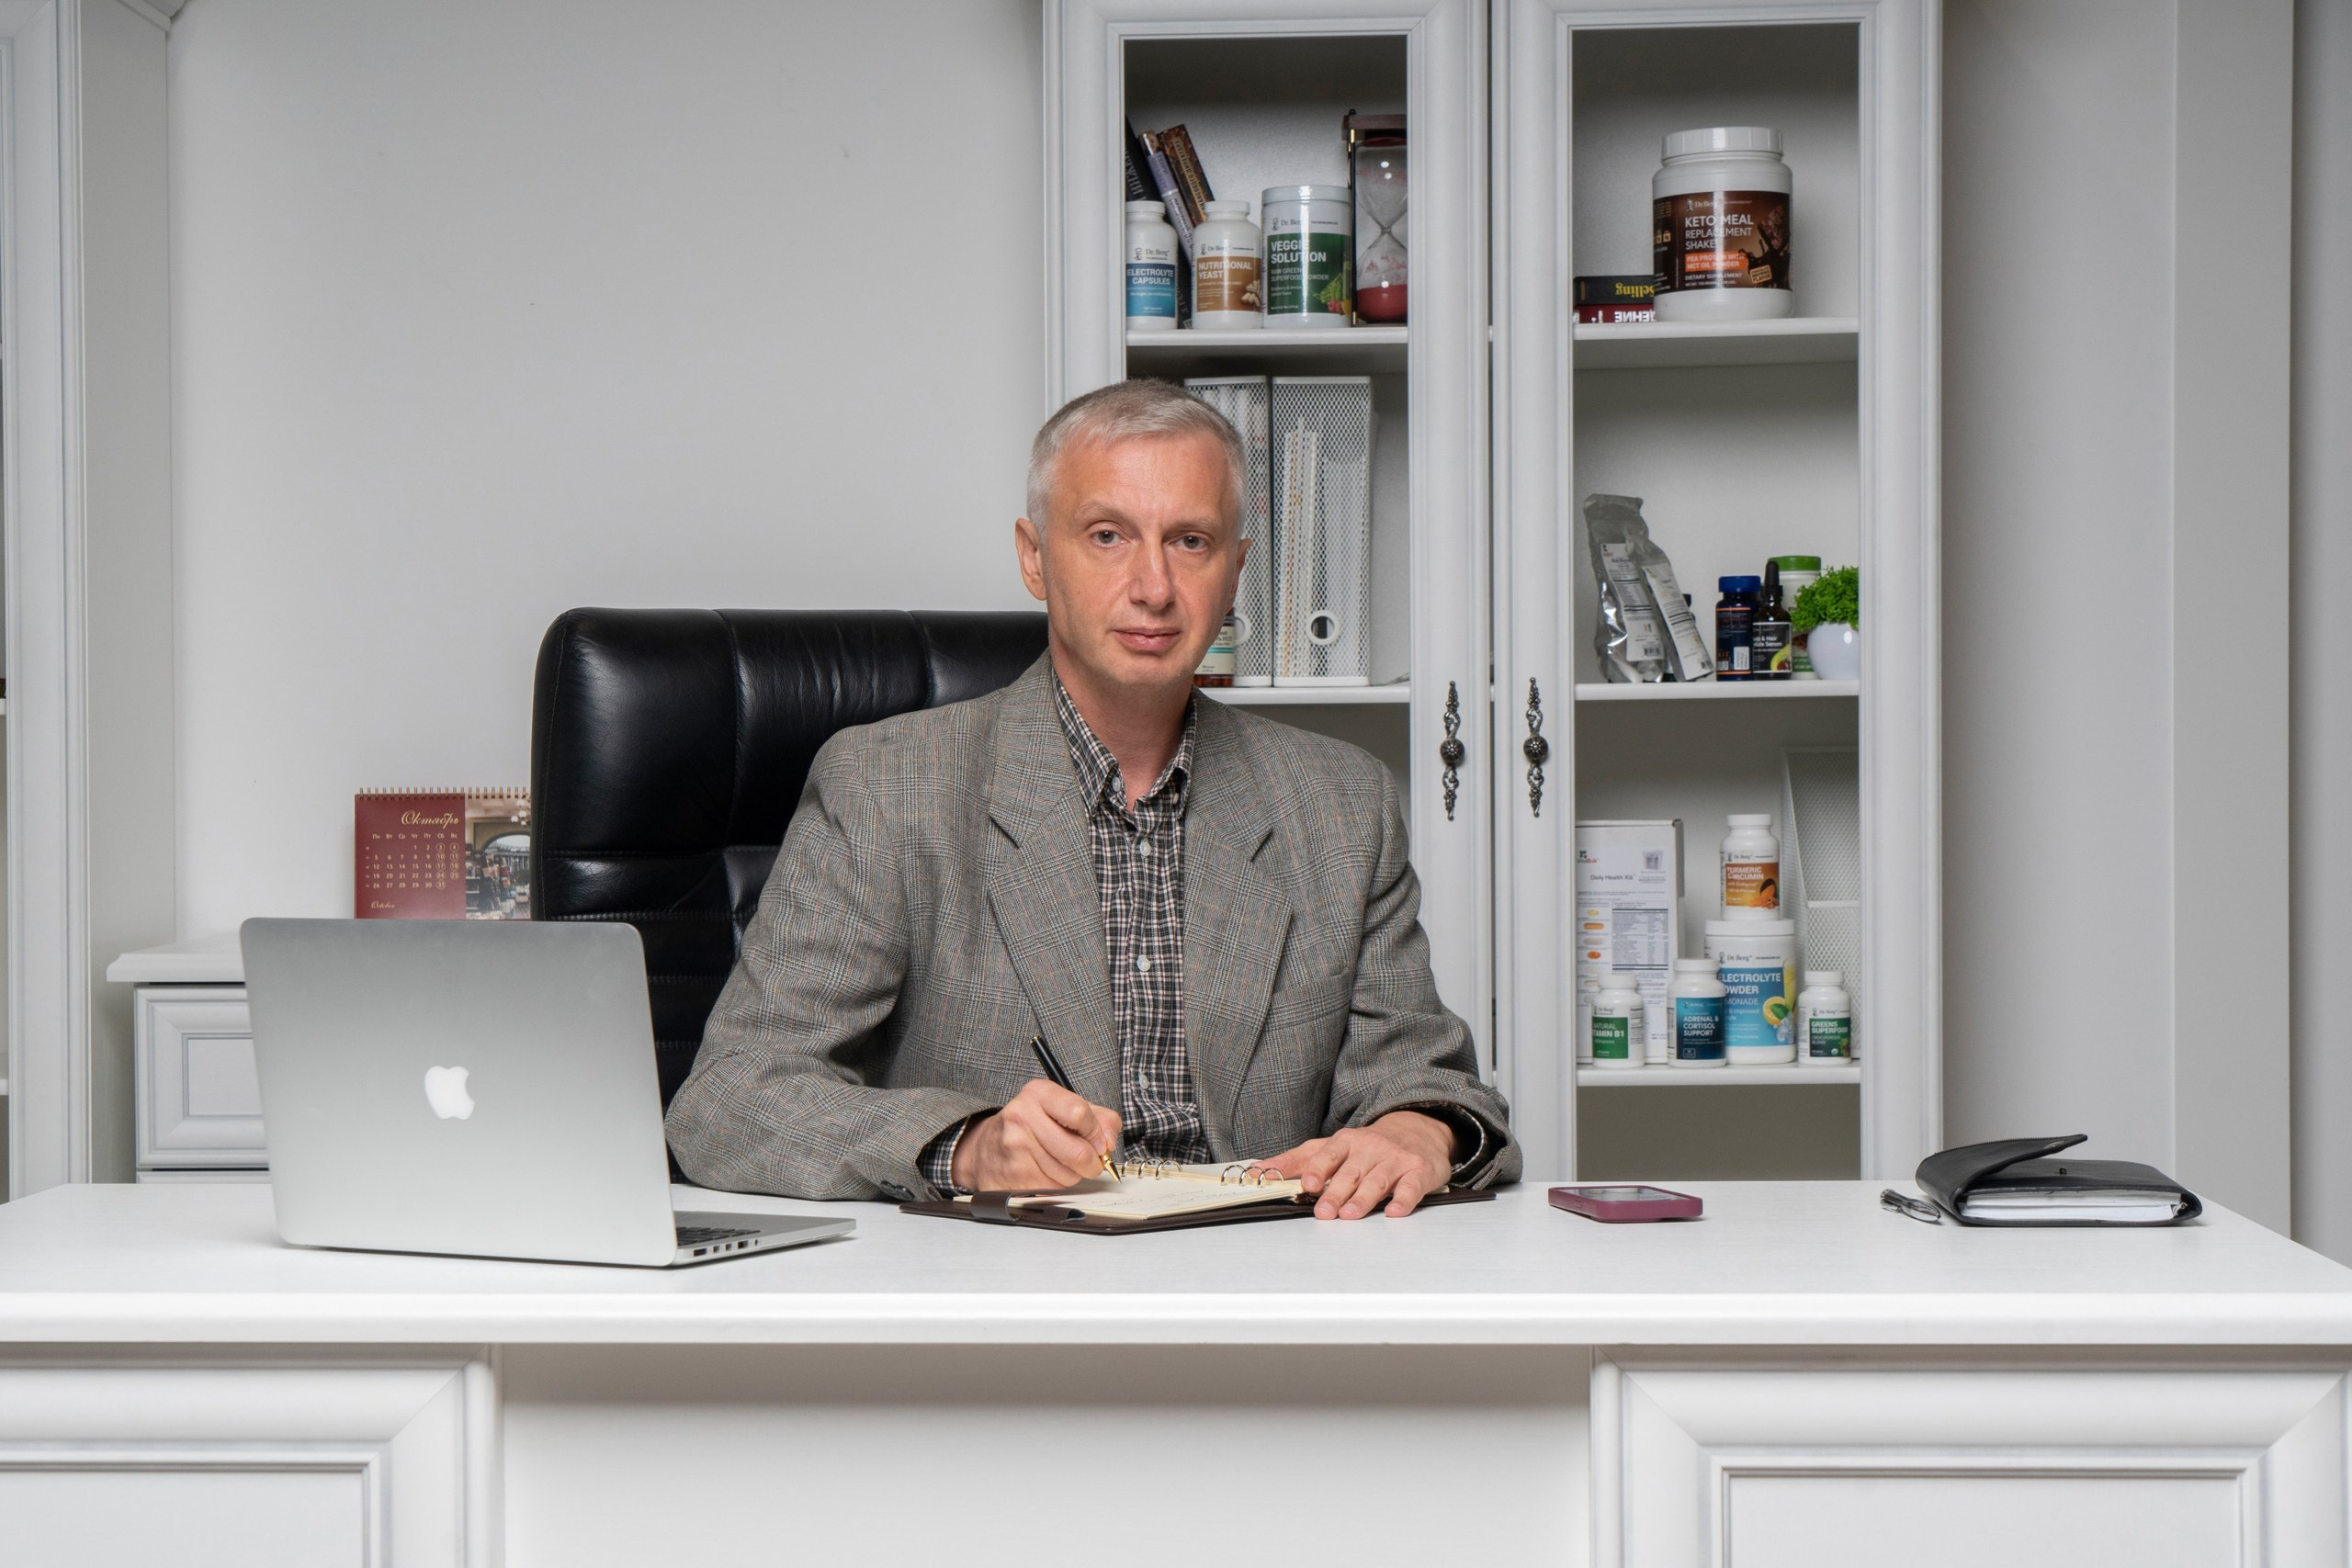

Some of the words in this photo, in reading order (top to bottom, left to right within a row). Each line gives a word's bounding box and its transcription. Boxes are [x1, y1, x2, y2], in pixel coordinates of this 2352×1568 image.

[1685, 215, 1715, 228] KETO
[1723, 214, 1754, 225] MEAL
[1685, 240, 1717, 250] SHAKE
[1126, 268, 1174, 277] ELECTROLYTE
[1198, 270, 1224, 279] YEAST
[1132, 277, 1170, 286] CAPSULES
[1614, 282, 1655, 299] Selling
[401, 810, 459, 829] Октябрь
[370, 900, 396, 908] October
[1724, 985, 1759, 995] OWDER
[1613, 1030, 1624, 1038] B1
[1683, 1029, 1713, 1037] SUPPORT
